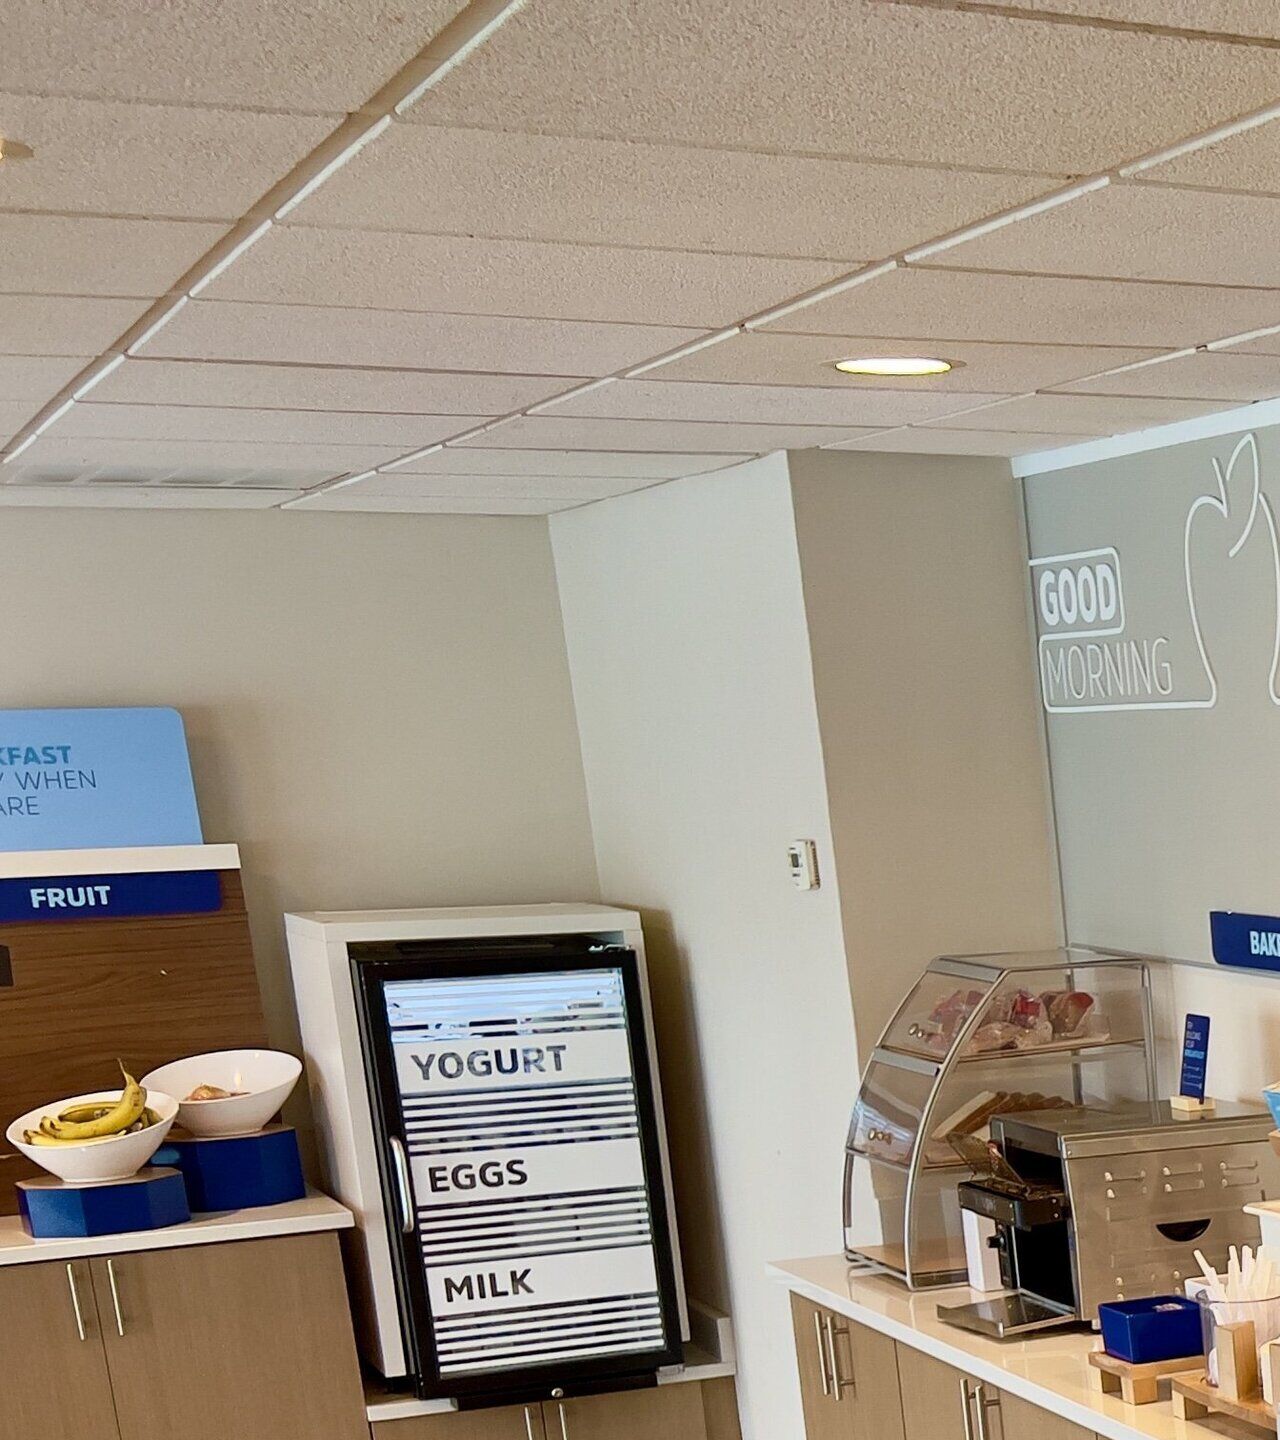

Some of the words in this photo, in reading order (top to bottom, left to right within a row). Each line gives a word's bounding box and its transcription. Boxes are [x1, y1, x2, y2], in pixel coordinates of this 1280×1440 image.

[1040, 563, 1117, 626] GOOD
[1046, 637, 1173, 700] MORNING
[15, 769, 96, 791] WHEN
[30, 885, 111, 909] FRUIT
[411, 1044, 567, 1081] YOGURT
[428, 1159, 528, 1193] EGGS
[444, 1268, 534, 1303] MILK
